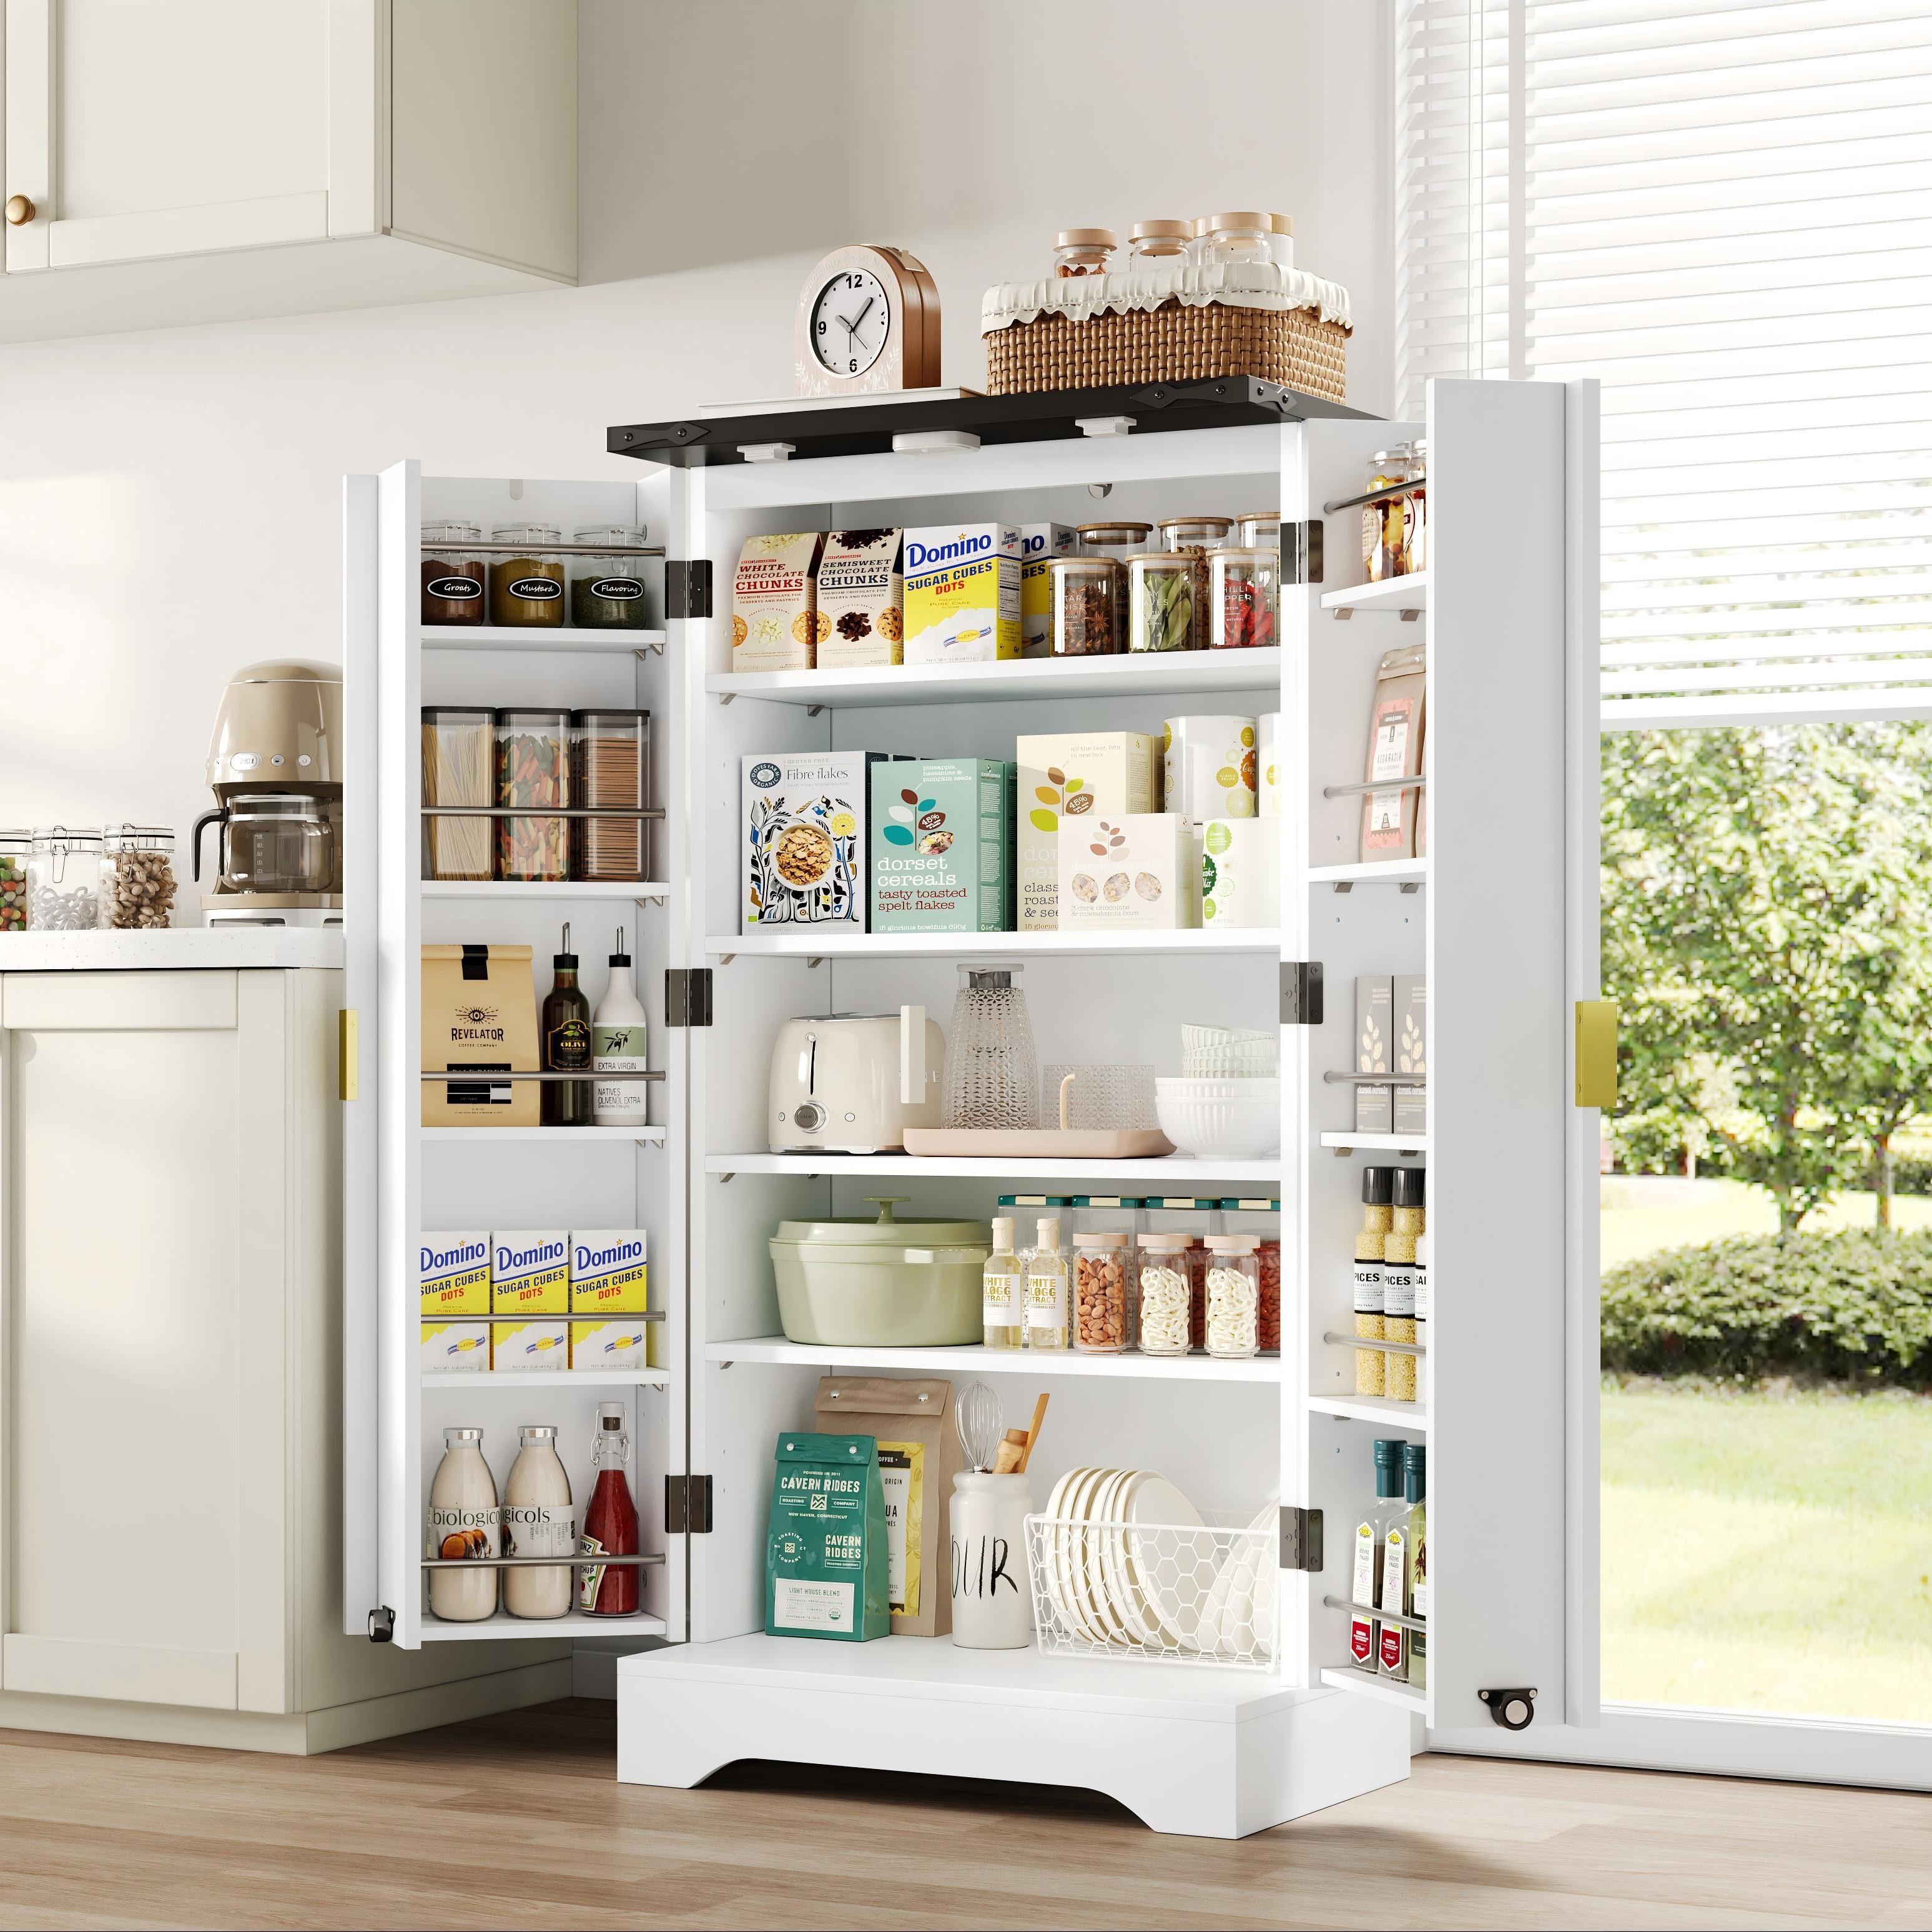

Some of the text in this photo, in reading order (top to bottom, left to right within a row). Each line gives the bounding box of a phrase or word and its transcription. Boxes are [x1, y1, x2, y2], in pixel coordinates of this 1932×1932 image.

[845, 274, 862, 288] 12
[818, 321, 827, 335] 9
[849, 358, 857, 373] 6
[906, 534, 992, 568] Domino
[739, 564, 786, 572] WHITE
[822, 559, 892, 568] SEMISWEET
[737, 571, 804, 579] CHOCOLATE
[821, 567, 889, 576] CHOCOLATE
[907, 573, 949, 591] SUGAR
[953, 562, 992, 580] CUBES
[736, 578, 803, 590] CHUNKS
[819, 574, 888, 586] CHUNKS
[443, 583, 472, 592] Groats
[520, 584, 554, 593] Mustard
[601, 584, 638, 594] Flavoring
[935, 580, 965, 595] DOTS
[751, 764, 780, 778] DOVES FARM
[787, 767, 848, 780] Fibre flakes
[753, 778, 779, 788] ORGANIC
[877, 856, 948, 870] dorset
[877, 872, 956, 887] cereals
[878, 888, 967, 900] tasty toasted
[879, 900, 955, 912] spelt flakes
[1024, 908, 1037, 918] &
[451, 1028, 504, 1042] REVELATOR
[598, 1062, 637, 1070] EXTRA VIRGIN
[598, 1088, 621, 1096] NATIVES
[1358, 1085, 1371, 1095] dorset
[1397, 1087, 1411, 1095] dorset
[421, 1243, 485, 1272] Domino
[496, 1242, 564, 1271] Domino
[574, 1241, 642, 1271] Domino
[455, 1270, 486, 1288] CUBES
[497, 1270, 564, 1295] SUGAR CUBES
[576, 1269, 643, 1294] SUGAR CUBES
[441, 1288, 465, 1301] DOTS
[520, 1287, 543, 1301] DOTS
[598, 1286, 622, 1300] DOTS
[781, 1477, 860, 1492] CAVERN RIDGES
[885, 1505, 897, 1517] UA
[778, 1532, 803, 1542] ROASTING
[826, 1535, 862, 1547] CAVERN
[826, 1547, 861, 1559] RIDGES
[779, 1555, 801, 1564] COMPANY
